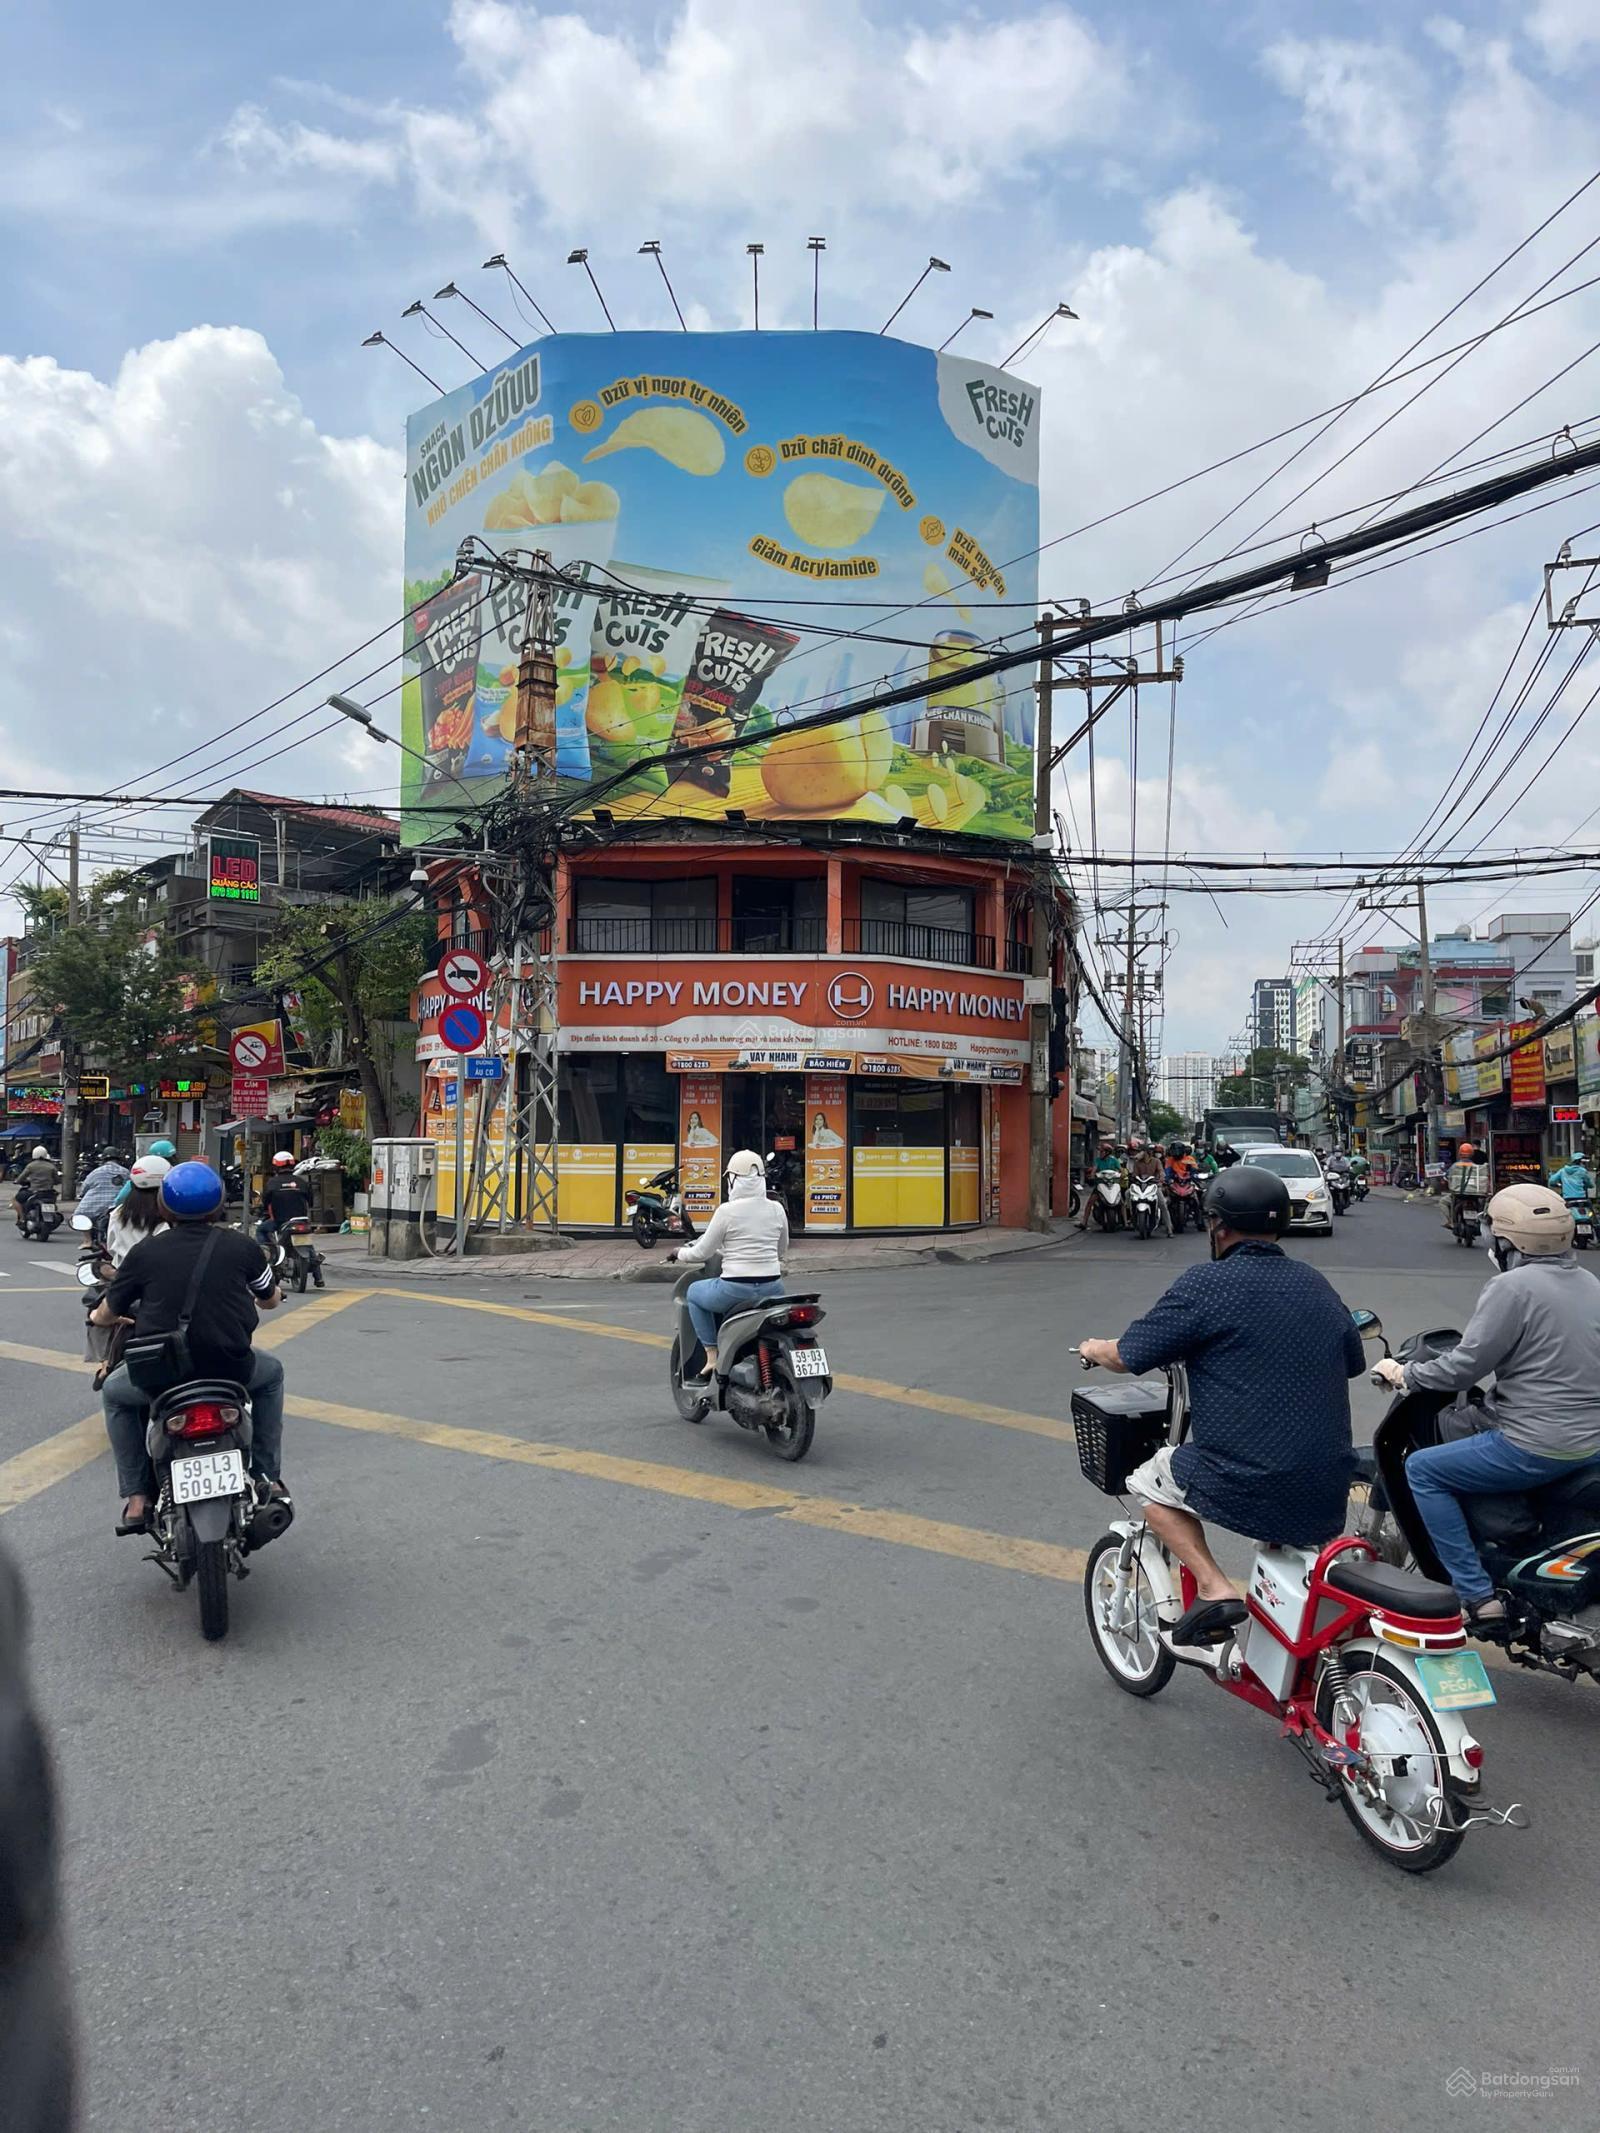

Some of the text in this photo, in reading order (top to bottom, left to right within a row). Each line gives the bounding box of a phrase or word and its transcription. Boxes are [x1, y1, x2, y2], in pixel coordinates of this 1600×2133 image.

[633, 376, 648, 396] vị
[652, 378, 686, 397] ngọt
[689, 384, 707, 404] tự
[707, 394, 746, 433] nhiên
[965, 379, 1035, 428] FRESH
[420, 421, 447, 459] SNACK
[811, 437, 844, 457] chất
[985, 417, 1025, 449] CUTS
[480, 441, 508, 479] CHÂN
[511, 418, 550, 458] KHÔNG
[412, 424, 466, 508] NGON
[751, 538, 877, 577] Giảm Acrylamide
[606, 619, 670, 653] CUTS
[697, 658, 752, 693] CUTS
[213, 856, 256, 881] LED
[579, 981, 808, 1006] HAPPY MONEY
[889, 983, 1026, 1022] HAPPY MONEY
[888, 1036, 922, 1048] HOTLINE:
[924, 1039, 940, 1049] 1800
[750, 1053, 798, 1062] VAY NHANH
[809, 1059, 825, 1068] BẢO
[868, 1064, 885, 1073] 1800
[183, 1455, 231, 1479] 59-L3
[180, 1473, 238, 1499] 509.42
[1438, 1678, 1478, 1693] PEGA
